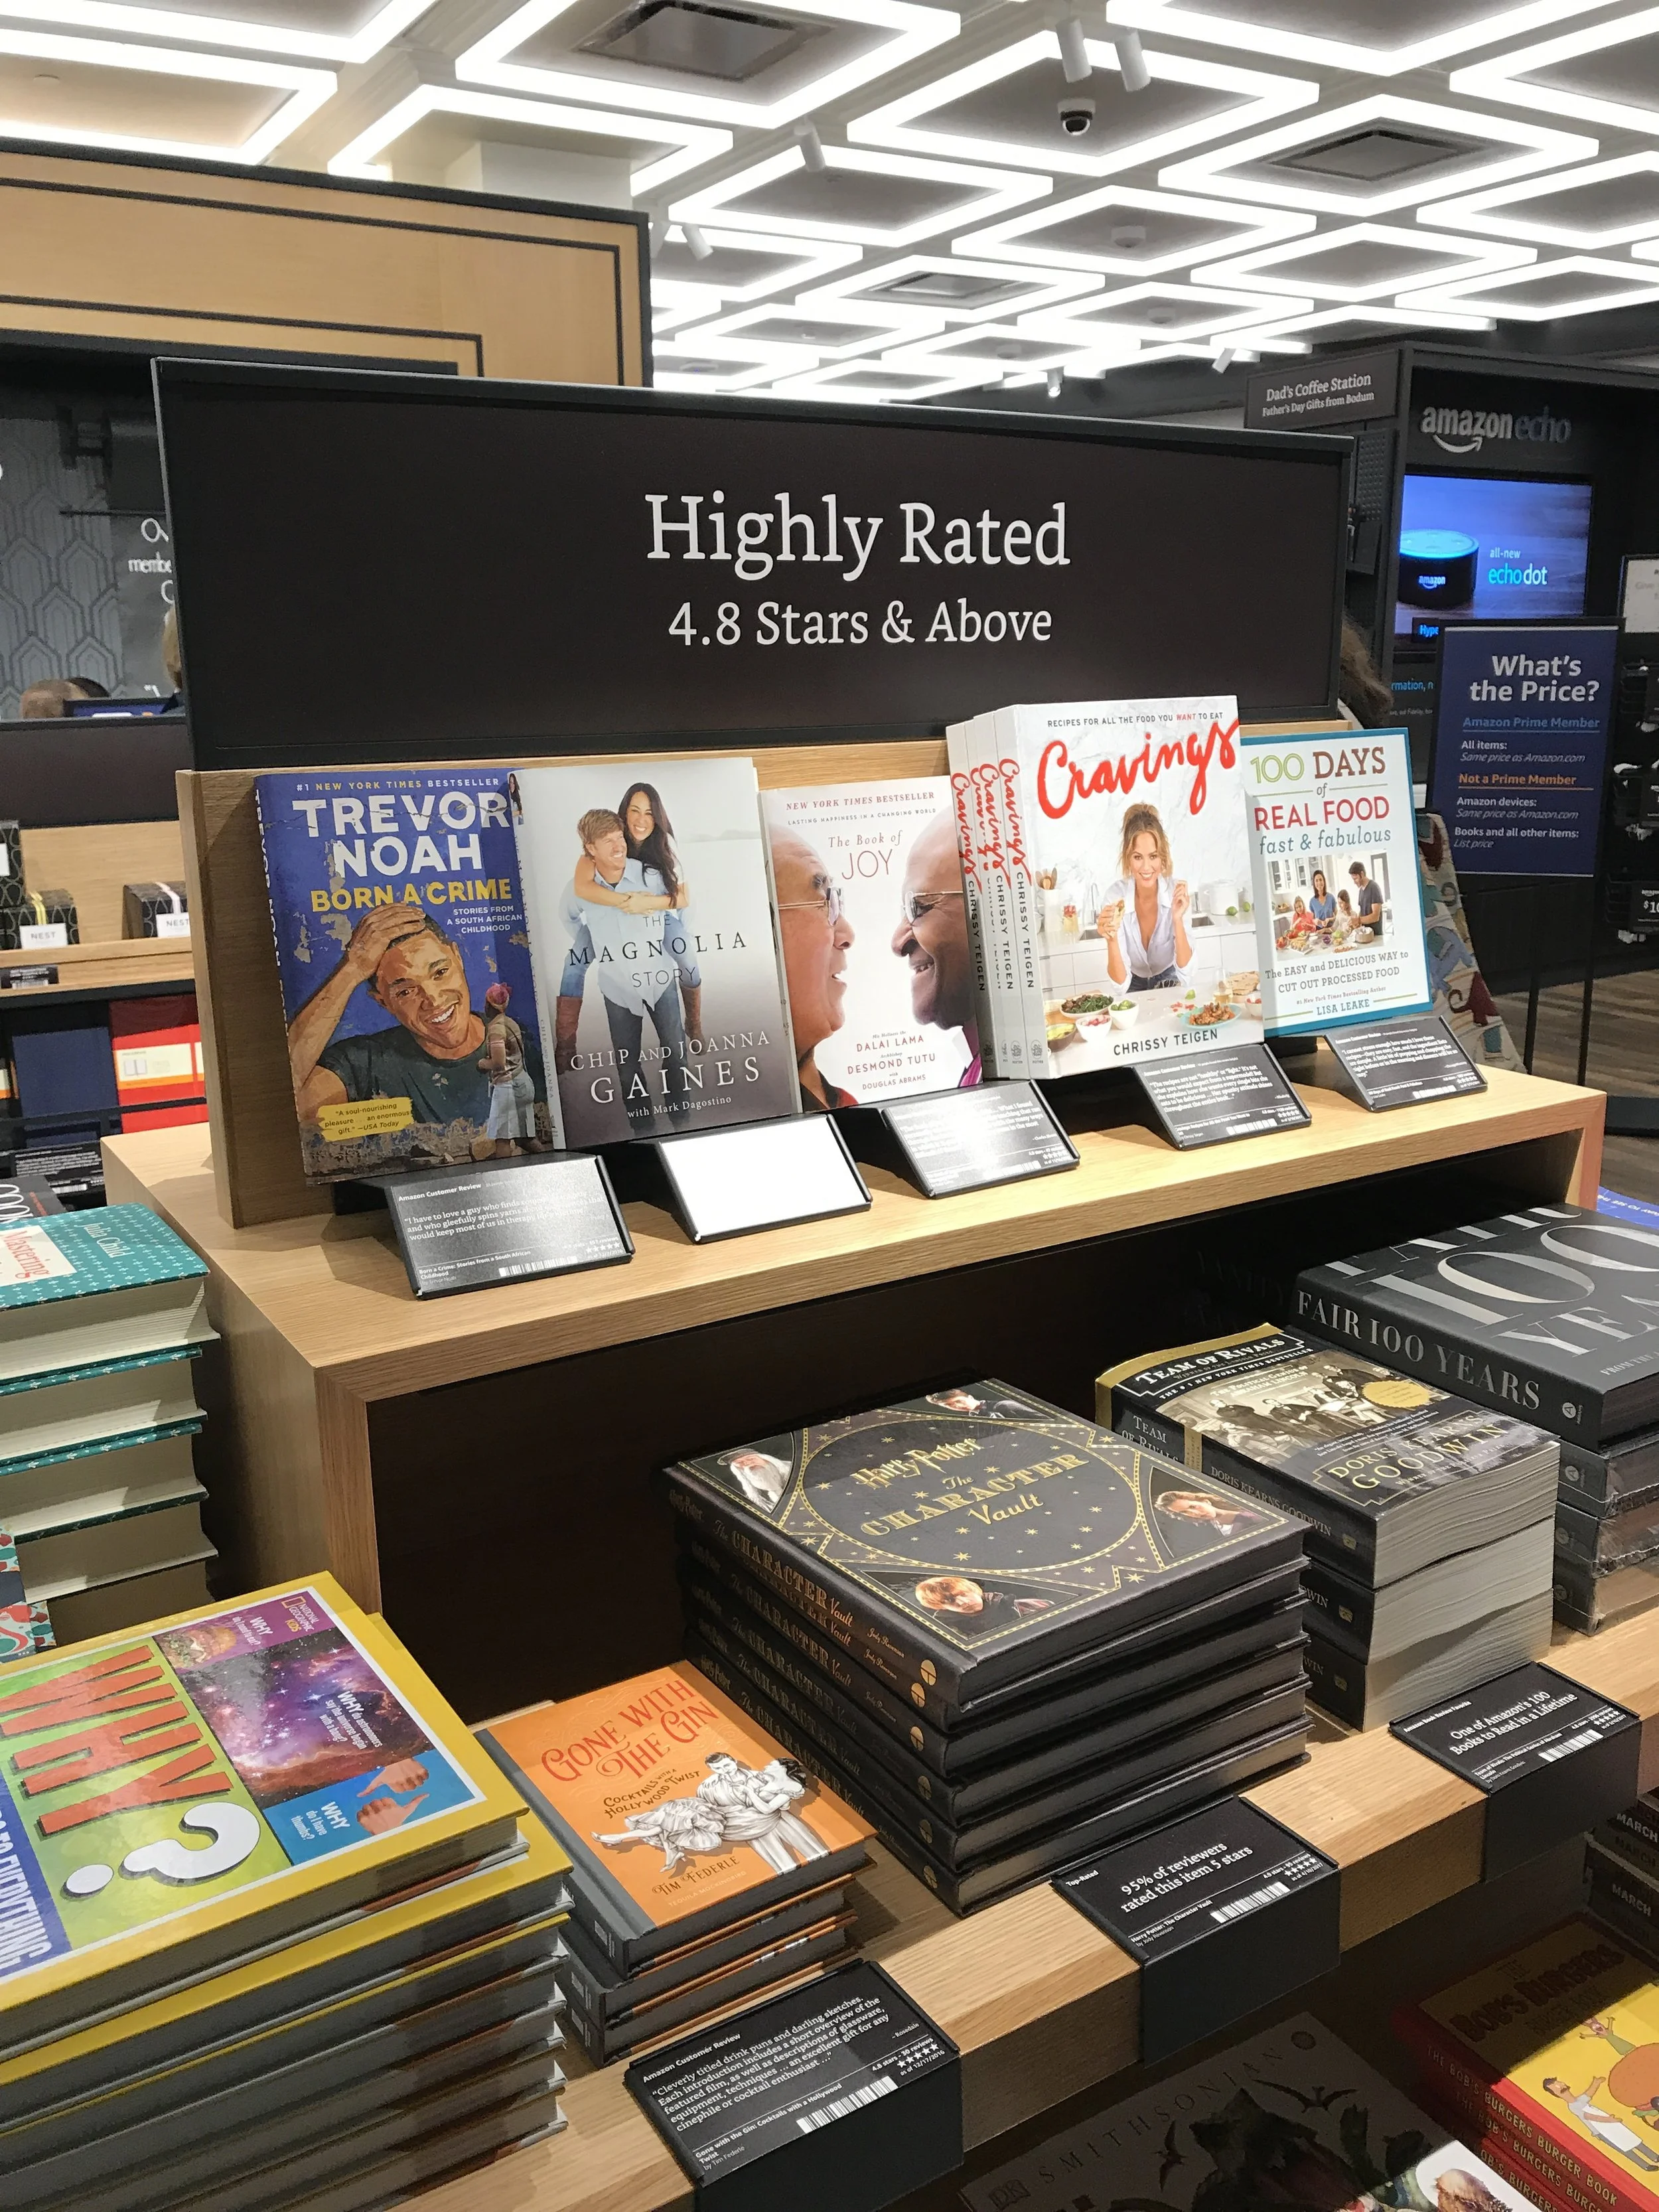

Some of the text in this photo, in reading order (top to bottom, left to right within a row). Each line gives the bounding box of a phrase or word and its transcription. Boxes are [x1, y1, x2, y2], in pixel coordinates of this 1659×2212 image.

[1266, 373, 1371, 402] Dad's Coffee Station
[1262, 392, 1374, 416] Father's Day Gifts from Bodum
[645, 490, 1071, 581] Highly Rated
[1490, 548, 1520, 558] all-new
[668, 598, 1052, 646] 4.8 Stars & Above
[1492, 654, 1581, 677] What's
[1469, 680, 1600, 701] the Price?
[1048, 719, 1081, 728] RECIPES
[1084, 717, 1099, 726] FOR
[1118, 715, 1133, 724] THE
[1136, 714, 1156, 723] FOOD
[1158, 713, 1173, 722] YOU
[1176, 713, 1196, 721] WANT
[1463, 717, 1600, 728] Amazon Prime Member
[1460, 753, 1486, 763] Same
[1488, 753, 1510, 764] price
[1525, 753, 1585, 763] Amazon.com
[1461, 740, 1508, 750] All items:
[1037, 717, 1239, 820] Cravings
[1250, 747, 1386, 783] 100 DAYS
[1459, 774, 1480, 784] Not
[1492, 774, 1526, 784] Prime
[1529, 774, 1577, 784] Member
[348, 780, 380, 789] YORK
[387, 779, 421, 788] TIMES
[427, 777, 499, 788] BESTSELLER
[1317, 782, 1327, 798] of
[292, 791, 510, 838] TREVOR
[1254, 796, 1390, 831] REAL FOOD
[1457, 797, 1537, 807] Amazon devices:
[828, 830, 903, 848] The Book of
[1260, 826, 1391, 855] fast & fabulous
[1454, 839, 1494, 849] List price
[1455, 827, 1579, 838] Books and all other items:
[332, 834, 484, 878] NOAH
[841, 849, 893, 880] JOY
[311, 878, 512, 912] BORN A CRIME
[453, 905, 514, 916] STORIES FROM
[455, 917, 484, 925] SOUTH
[486, 914, 522, 923] AFRICAN
[643, 914, 671, 928] THE
[31, 931, 56, 940] NEST
[461, 924, 510, 934] CHILDHOOD
[569, 932, 747, 966] MAGNOLIA
[632, 967, 696, 988] STORY
[1265, 950, 1409, 979] The EASY and DELICIOUS WAY to
[1278, 967, 1400, 994] CUT OUT PROCESSED FOOD
[1317, 999, 1370, 1015] LISA LEAKE
[570, 1030, 770, 1070] CHIP AND JOANNA
[856, 1035, 924, 1053] DALAI LAMA
[1114, 1028, 1218, 1056] CHRISSY TEIGEN
[847, 1053, 936, 1075] DESMOND TUTU
[590, 1057, 760, 1104] GAINES
[628, 1096, 731, 1118] with Mark Dagostino
[1135, 1339, 1285, 1385] TEAM OF RIVALS
[1297, 1290, 1361, 1340] FAIR
[1435, 1345, 1541, 1410] YEARS
[1329, 1415, 1485, 1479] DORIS KEARNS
[1352, 1424, 1508, 1489] GOODWIN
[850, 1438, 983, 1491] Harry Potter
[861, 1454, 1090, 1536] CHARACTER
[942, 1474, 974, 1491] The
[968, 1493, 1044, 1525] Vault
[1449, 1736, 1485, 1755] Books
[1481, 1732, 1496, 1741] to
[1491, 1722, 1518, 1736] Read
[1516, 1715, 1532, 1726] in
[1533, 1693, 1578, 1716] Lifetime
[1450, 1691, 1551, 1739] One of Amazon's 100
[541, 1680, 695, 1781] GONE WITH
[596, 1701, 719, 1779] THE GIN
[1120, 1847, 1254, 1913] rated this item 5 stars
[1121, 1842, 1228, 1895] 95% of reviewers
[1484, 2091, 1619, 2206] BURGERS BURGER BOOK
